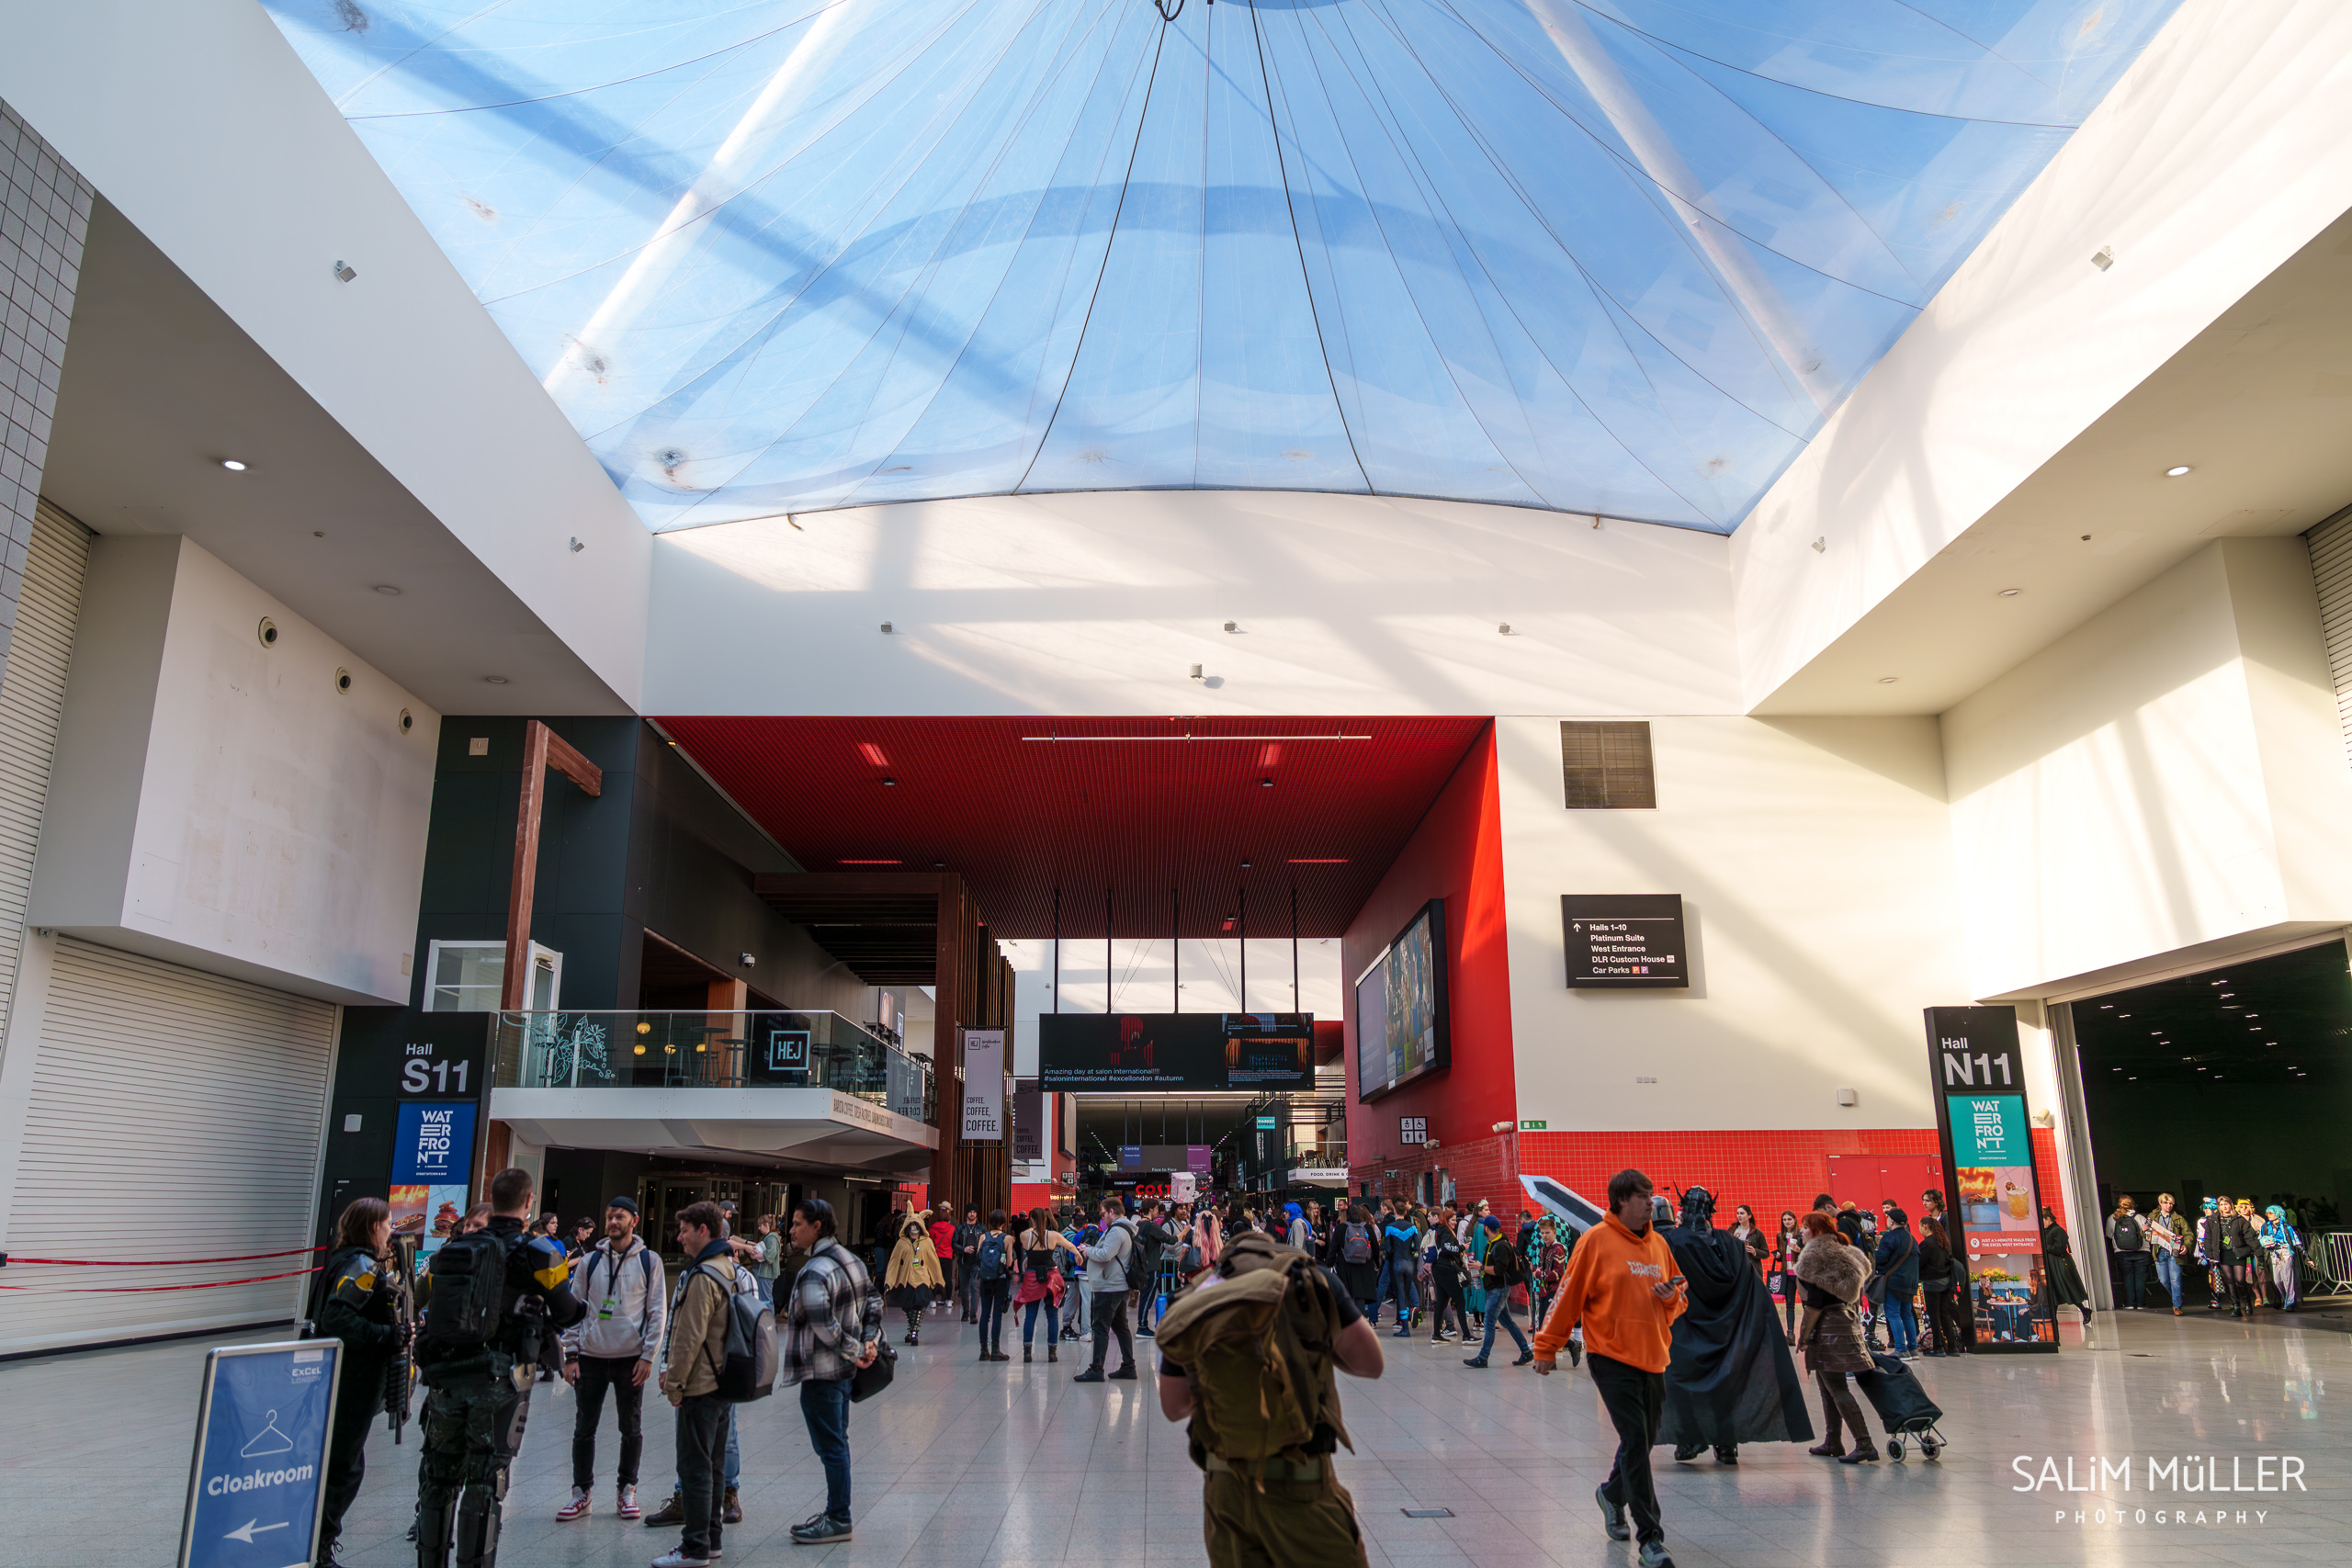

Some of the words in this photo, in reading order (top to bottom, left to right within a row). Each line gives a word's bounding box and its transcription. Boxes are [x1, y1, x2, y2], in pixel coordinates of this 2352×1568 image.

[405, 1043, 433, 1055] Hall
[1941, 1037, 1968, 1049] Hall
[777, 1041, 802, 1060] HEJ
[401, 1058, 469, 1093] S11
[1943, 1053, 2012, 1086] N11
[967, 1096, 985, 1104] COFFEE,
[1971, 1100, 2000, 1112] WAT
[421, 1110, 454, 1123] WAT
[966, 1107, 991, 1117] COFFEE,
[1973, 1112, 2002, 1124] ER
[420, 1123, 451, 1136] ER
[966, 1120, 999, 1132] COFFEE.
[1974, 1125, 2004, 1137] FRO
[418, 1137, 451, 1150] FRO
[1976, 1137, 2005, 1149] NT
[1016, 1145, 1040, 1155] COFFEE.
[417, 1151, 449, 1164] NT
[1136, 1184, 1171, 1197] COST
[207, 1463, 313, 1496] Cloakroom
